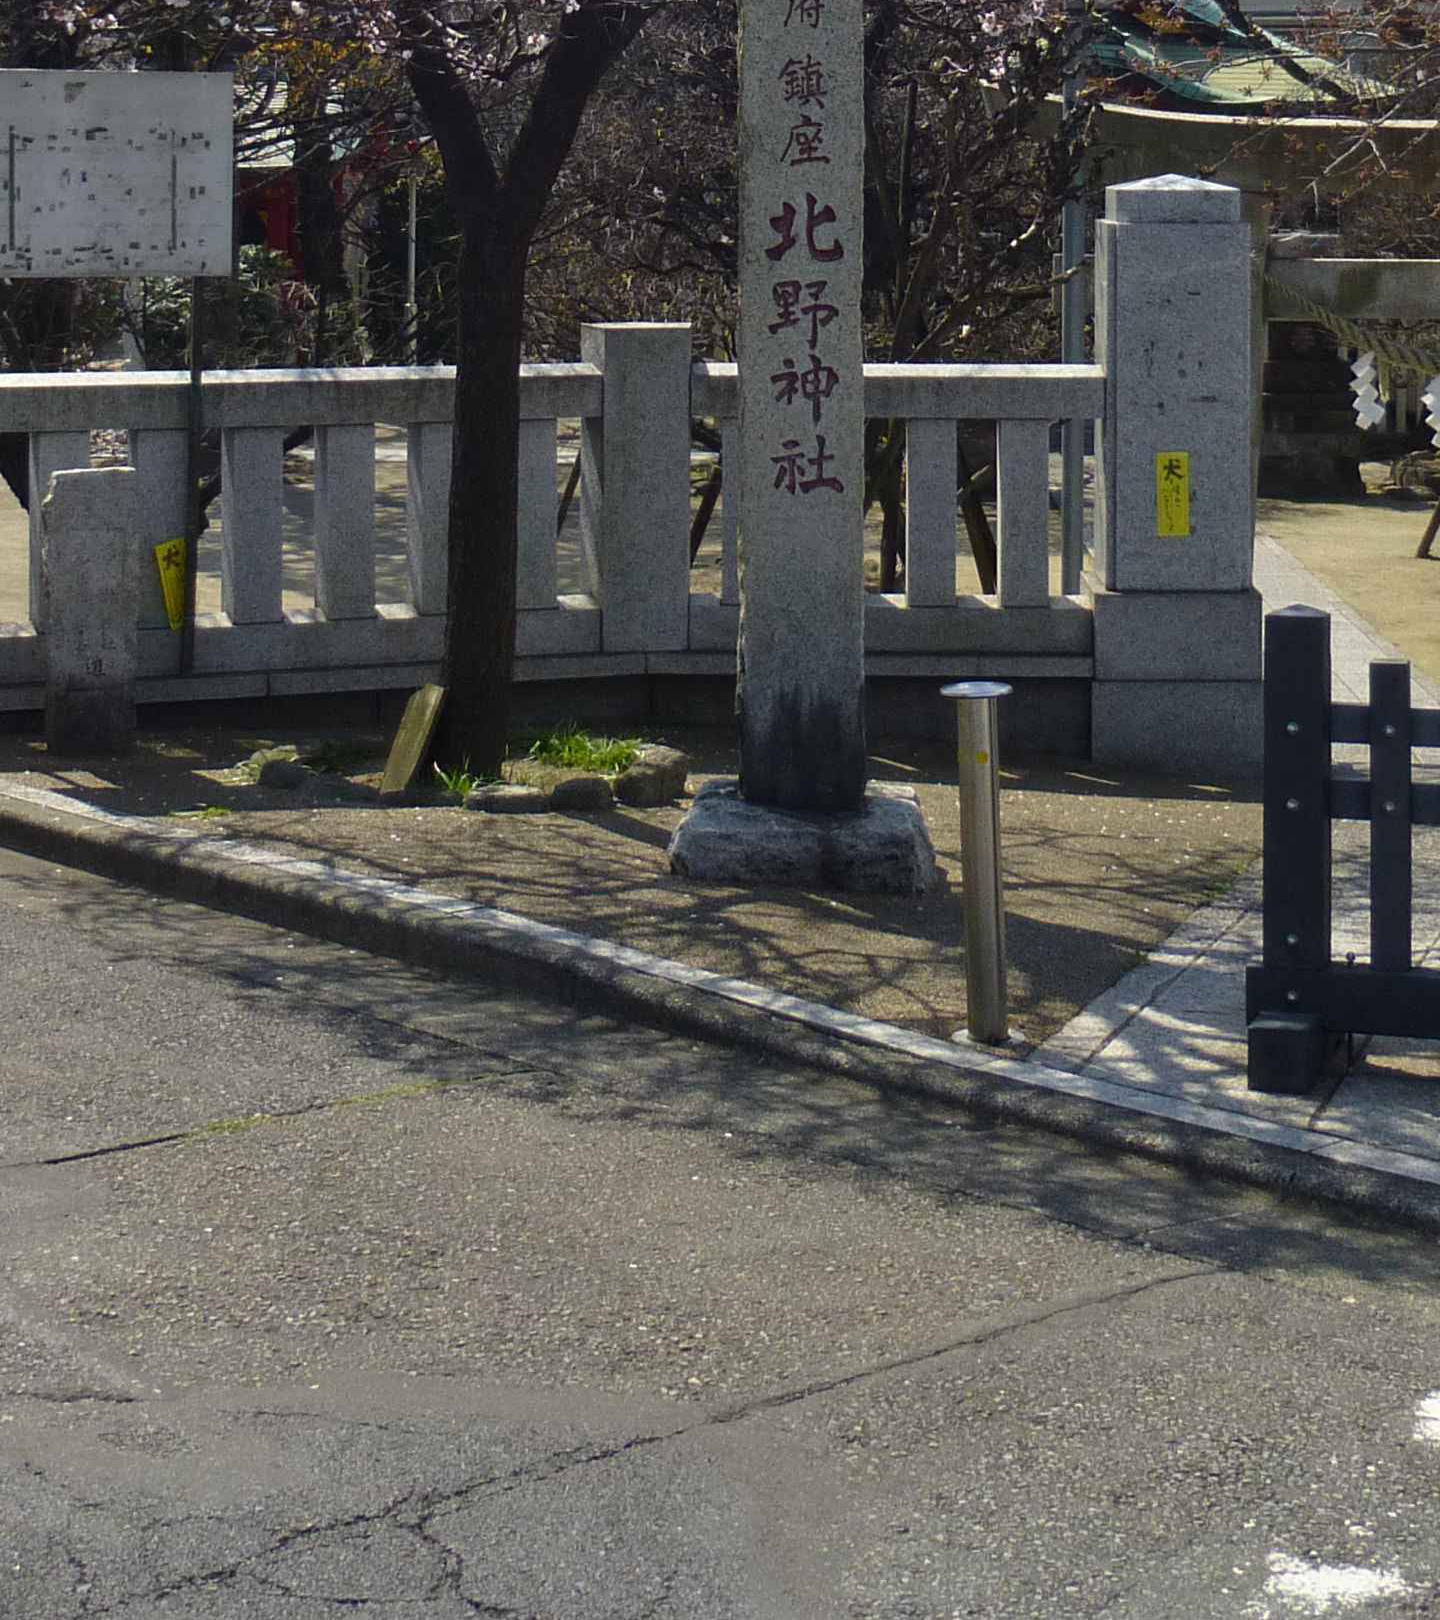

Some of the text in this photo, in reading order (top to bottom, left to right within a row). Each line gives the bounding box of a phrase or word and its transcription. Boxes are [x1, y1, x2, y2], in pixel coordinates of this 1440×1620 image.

[765, 192, 844, 494] 北野神社
[1163, 459, 1184, 481] 犬
